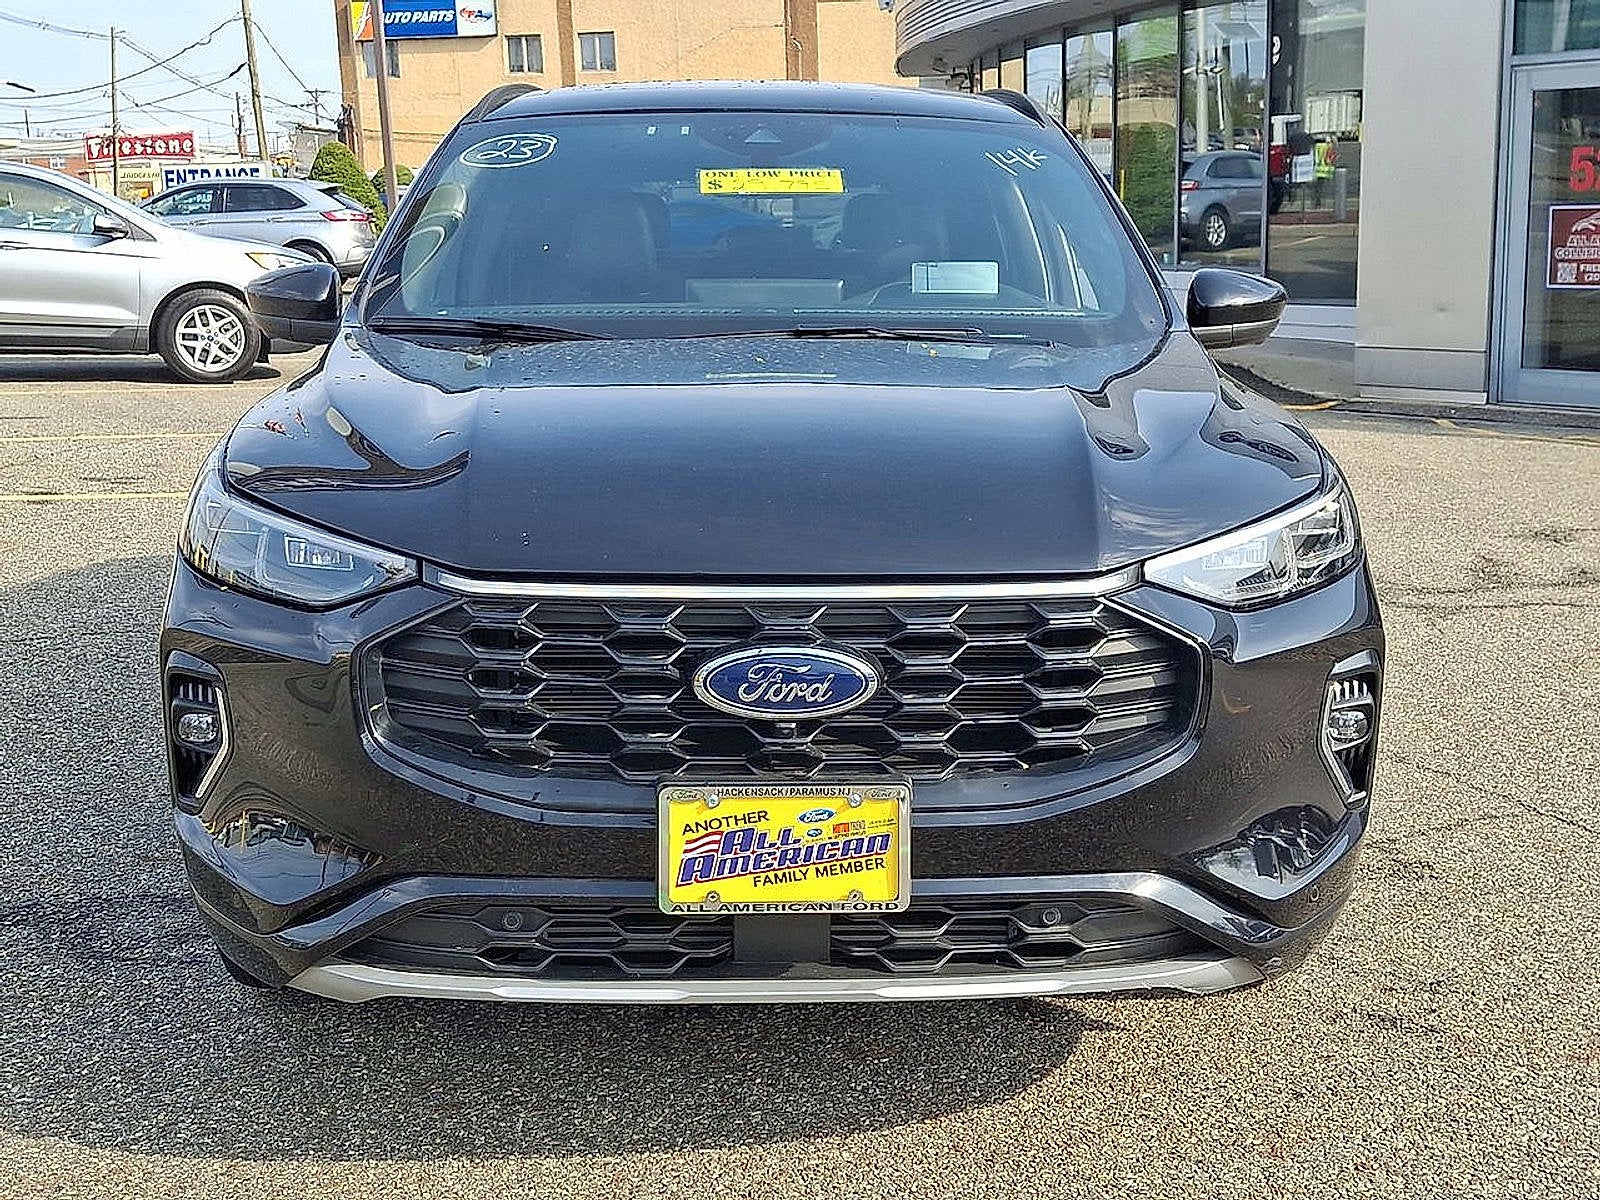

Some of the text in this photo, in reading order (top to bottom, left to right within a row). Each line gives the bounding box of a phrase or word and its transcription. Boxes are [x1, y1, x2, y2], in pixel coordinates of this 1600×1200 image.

[412, 10, 456, 23] PARTS
[477, 139, 543, 160] 23
[747, 170, 781, 178] LOW
[789, 170, 837, 178] PRICE
[1569, 146, 1600, 192] 5
[738, 662, 836, 703] Ford
[682, 810, 770, 835] ANOTHER
[753, 858, 886, 888] FAMILY MEMBER
[670, 901, 900, 913] ALL AMERICAN FORD
